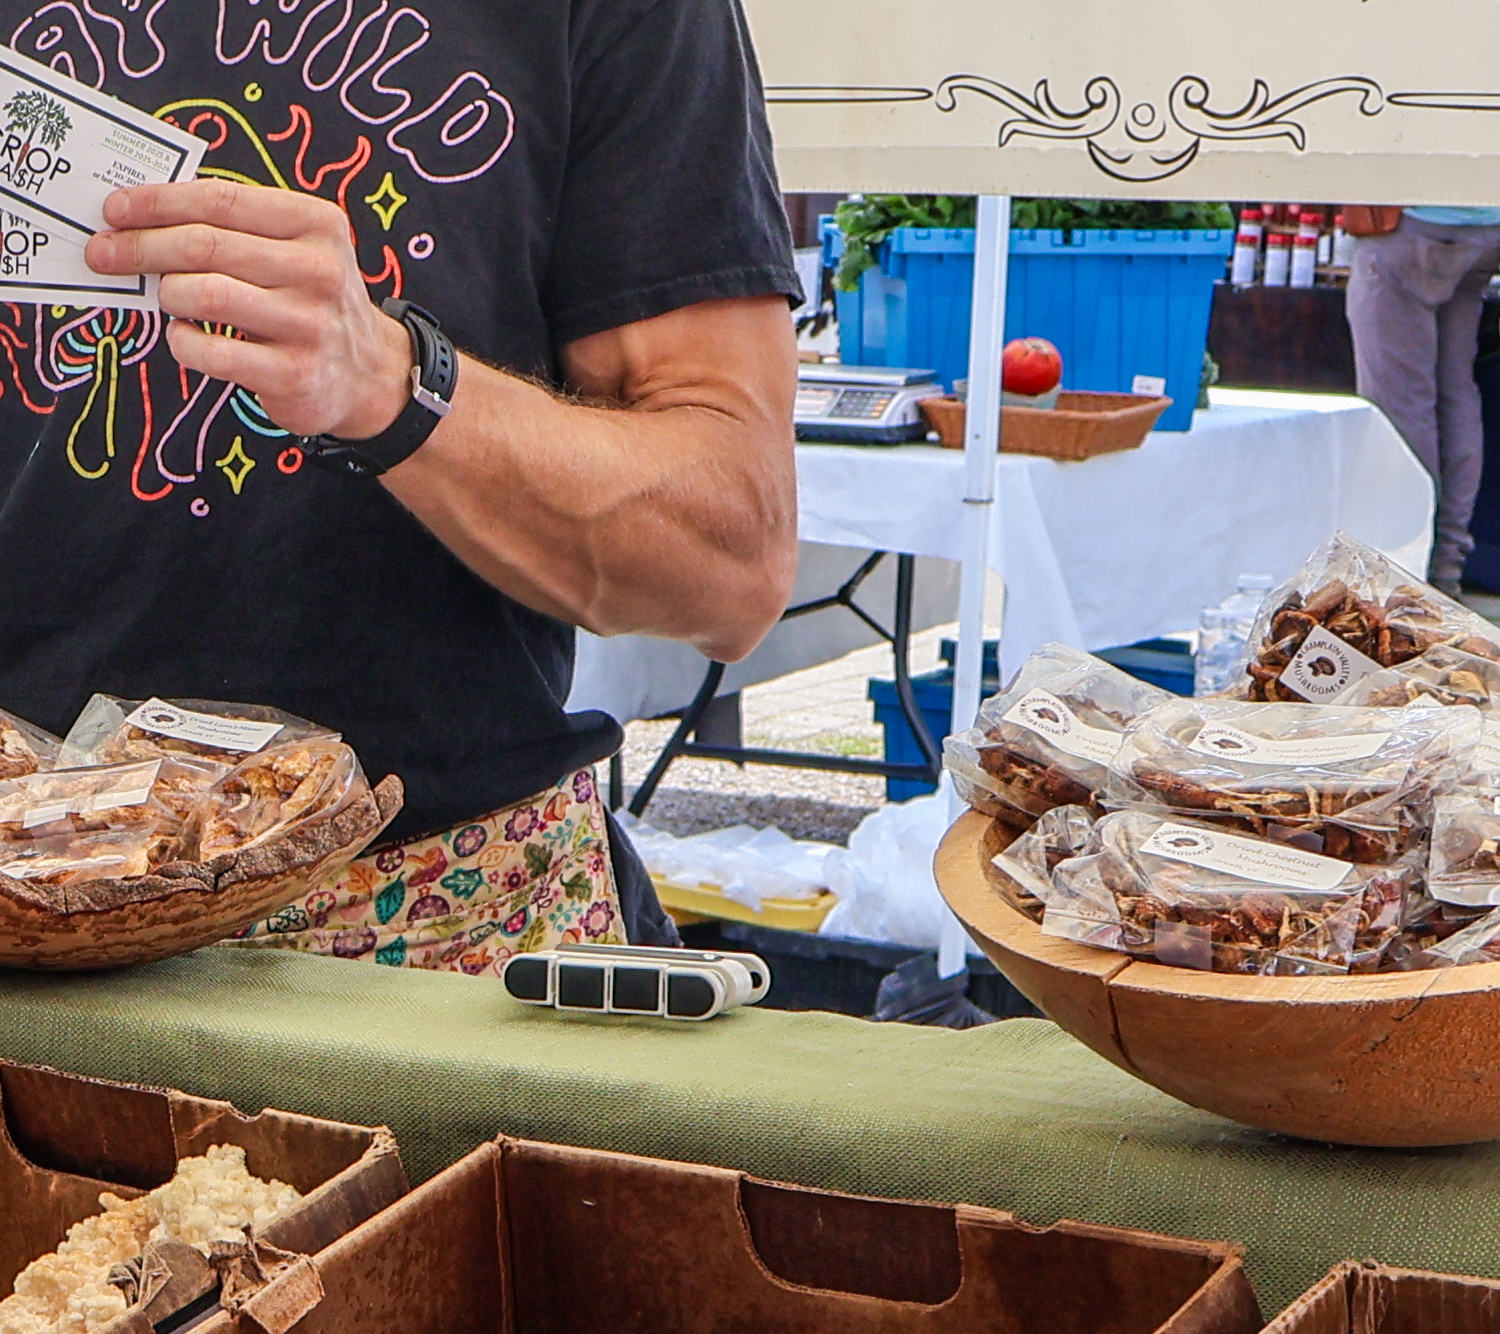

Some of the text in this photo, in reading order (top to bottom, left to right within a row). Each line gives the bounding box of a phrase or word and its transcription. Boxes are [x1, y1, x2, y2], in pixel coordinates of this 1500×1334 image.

[104, 137, 134, 154] WINTER
[112, 130, 147, 149] SUMMER
[147, 145, 163, 159] 2025
[112, 161, 146, 181] EXPIRES
